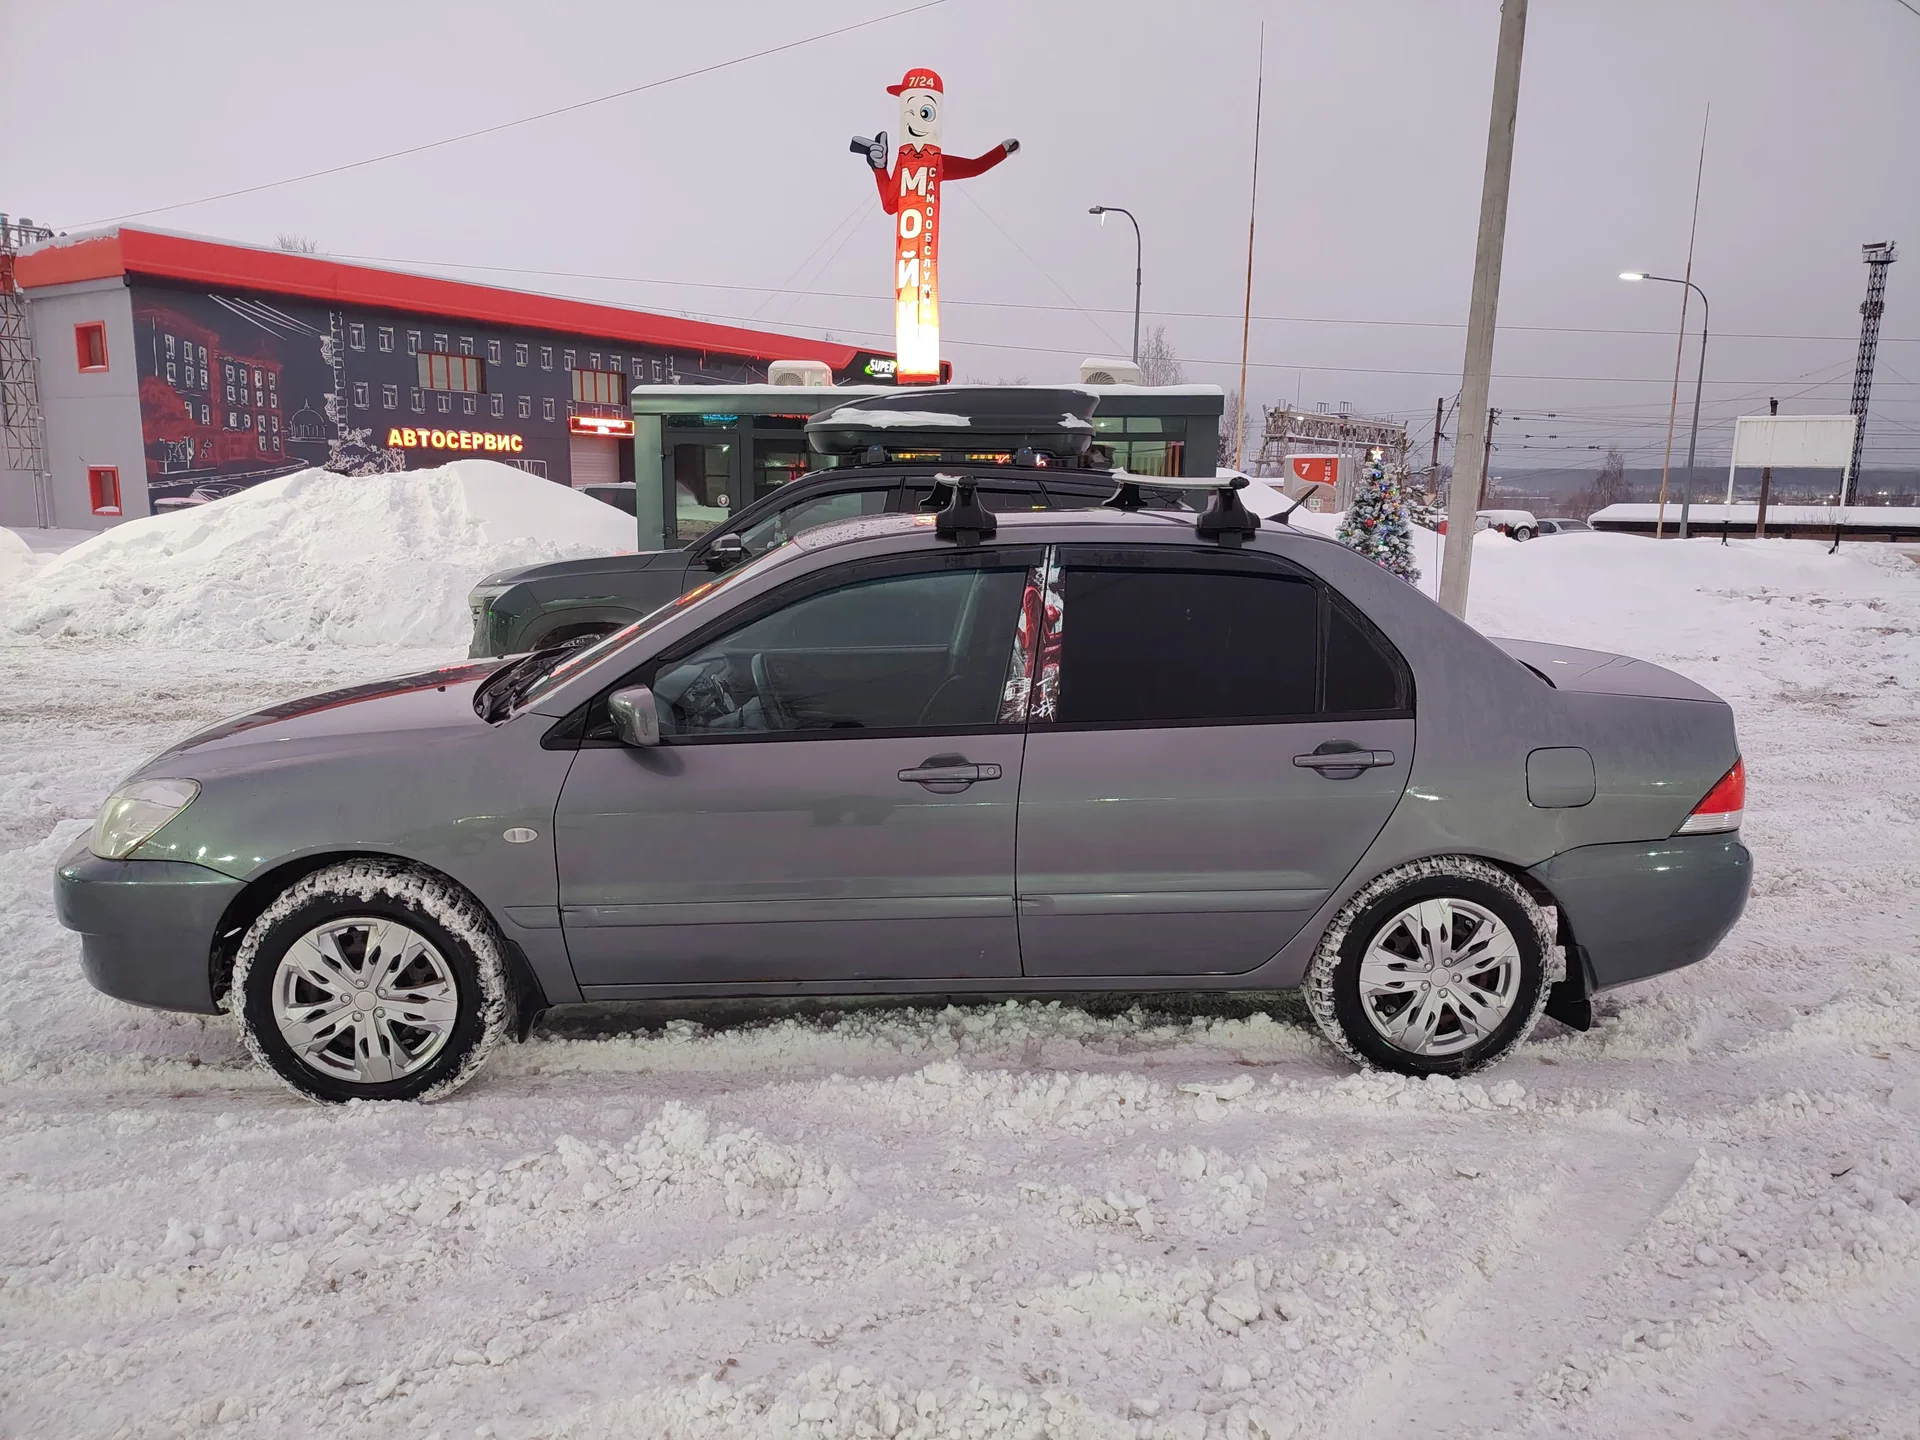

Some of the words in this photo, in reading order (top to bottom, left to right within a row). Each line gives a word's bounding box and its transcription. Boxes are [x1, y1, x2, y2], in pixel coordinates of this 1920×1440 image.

[908, 76, 934, 87] 7/24
[869, 359, 895, 373] SUPER
[388, 429, 523, 452] АВТОСЕРВИС
[1301, 463, 1310, 475] 7
